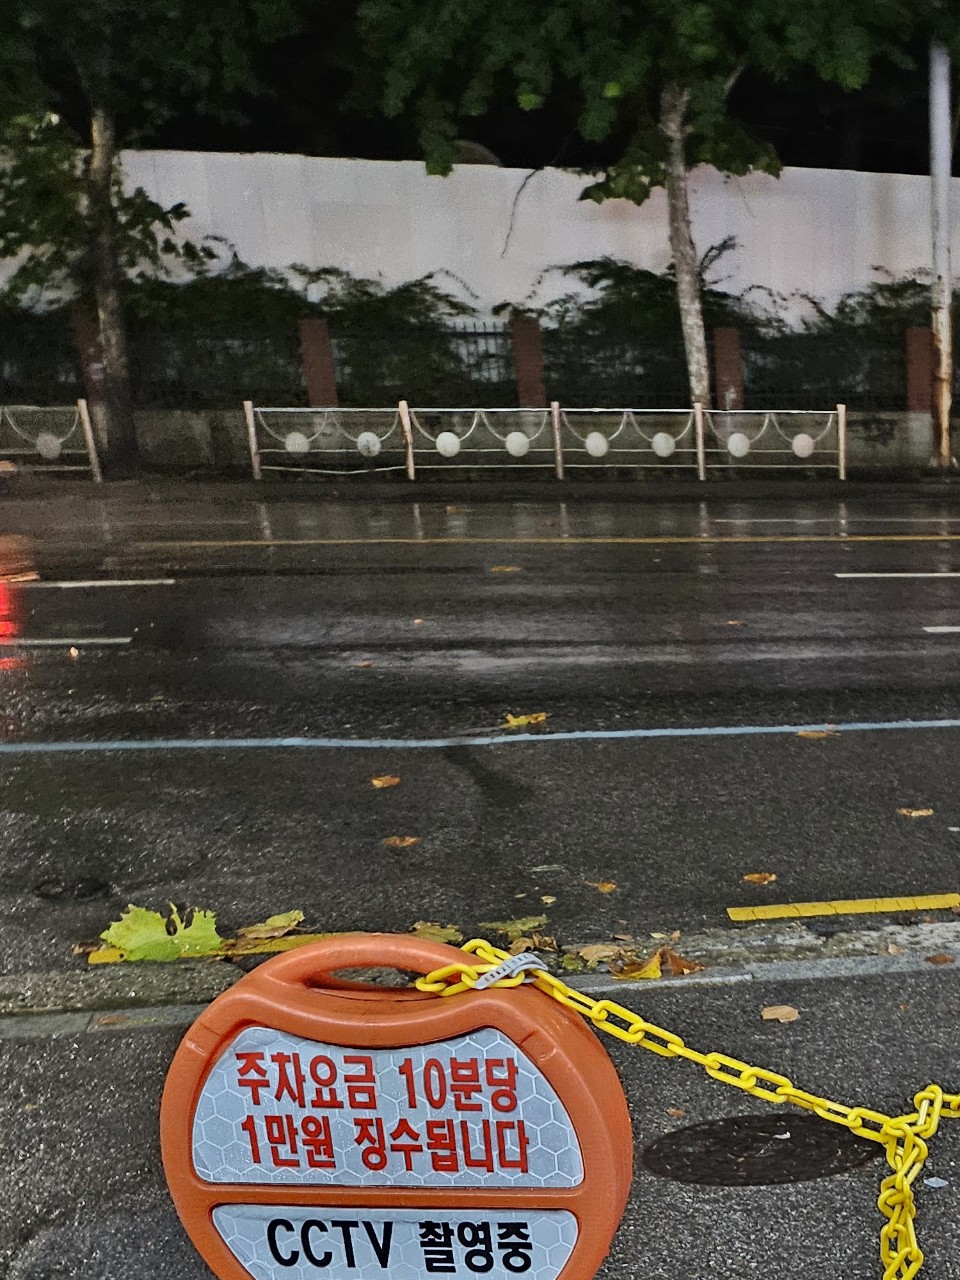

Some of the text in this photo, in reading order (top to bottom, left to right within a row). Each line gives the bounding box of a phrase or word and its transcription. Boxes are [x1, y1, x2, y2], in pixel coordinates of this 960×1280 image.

[236, 1052, 519, 1113] 주차요금 10분당
[241, 1113, 530, 1174] 1만원 징수됩니다
[267, 1218, 533, 1273] CCTV 촬영중
